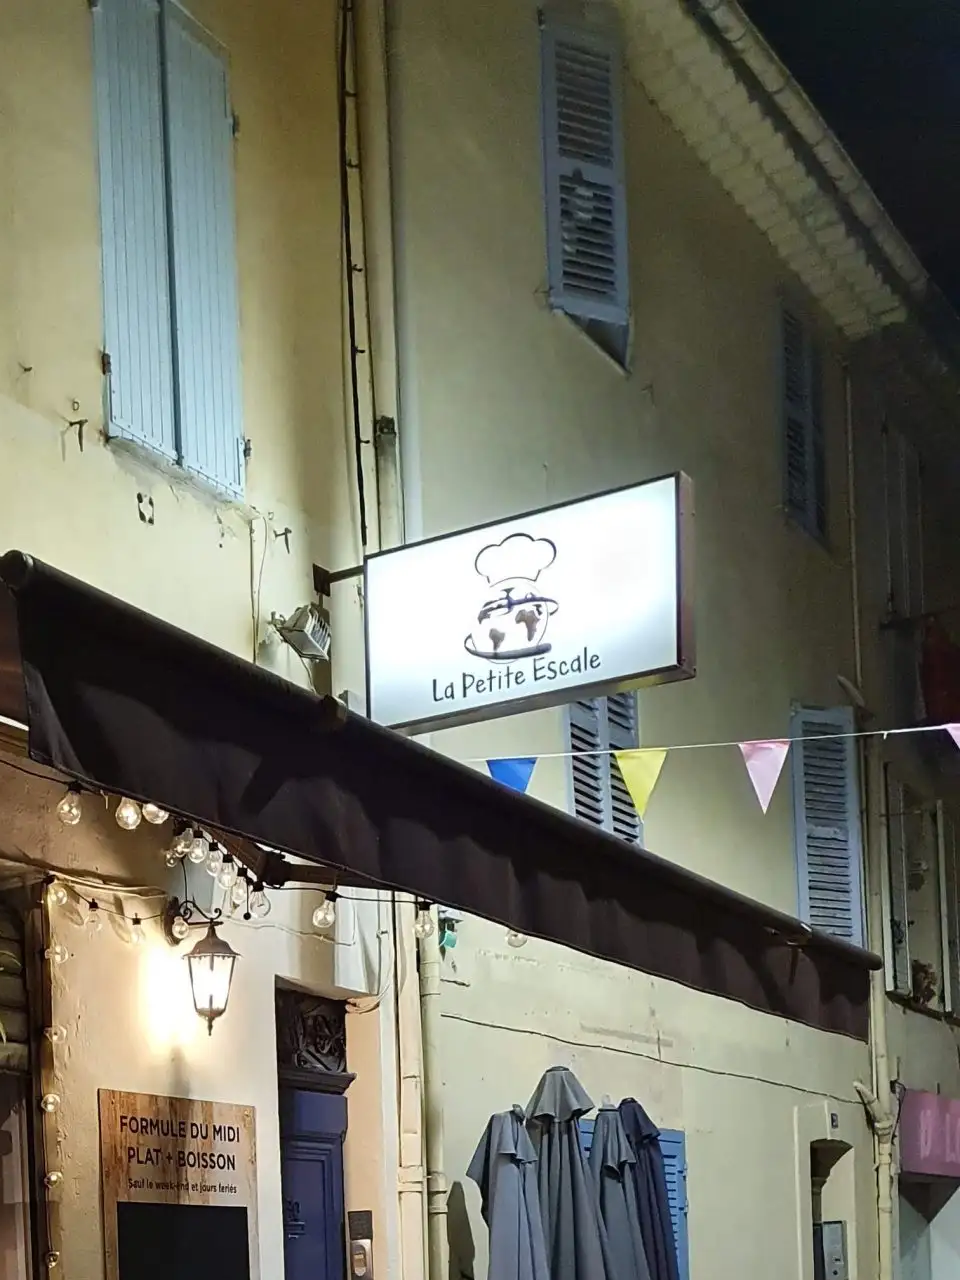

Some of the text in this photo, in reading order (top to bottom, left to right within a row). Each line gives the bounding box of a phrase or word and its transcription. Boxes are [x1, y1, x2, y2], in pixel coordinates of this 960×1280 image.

[432, 647, 602, 702] La Petite Escale
[119, 1115, 241, 1143] FORMULE DU MIDI
[127, 1146, 162, 1166] PLAT
[177, 1150, 236, 1171] BOISSON
